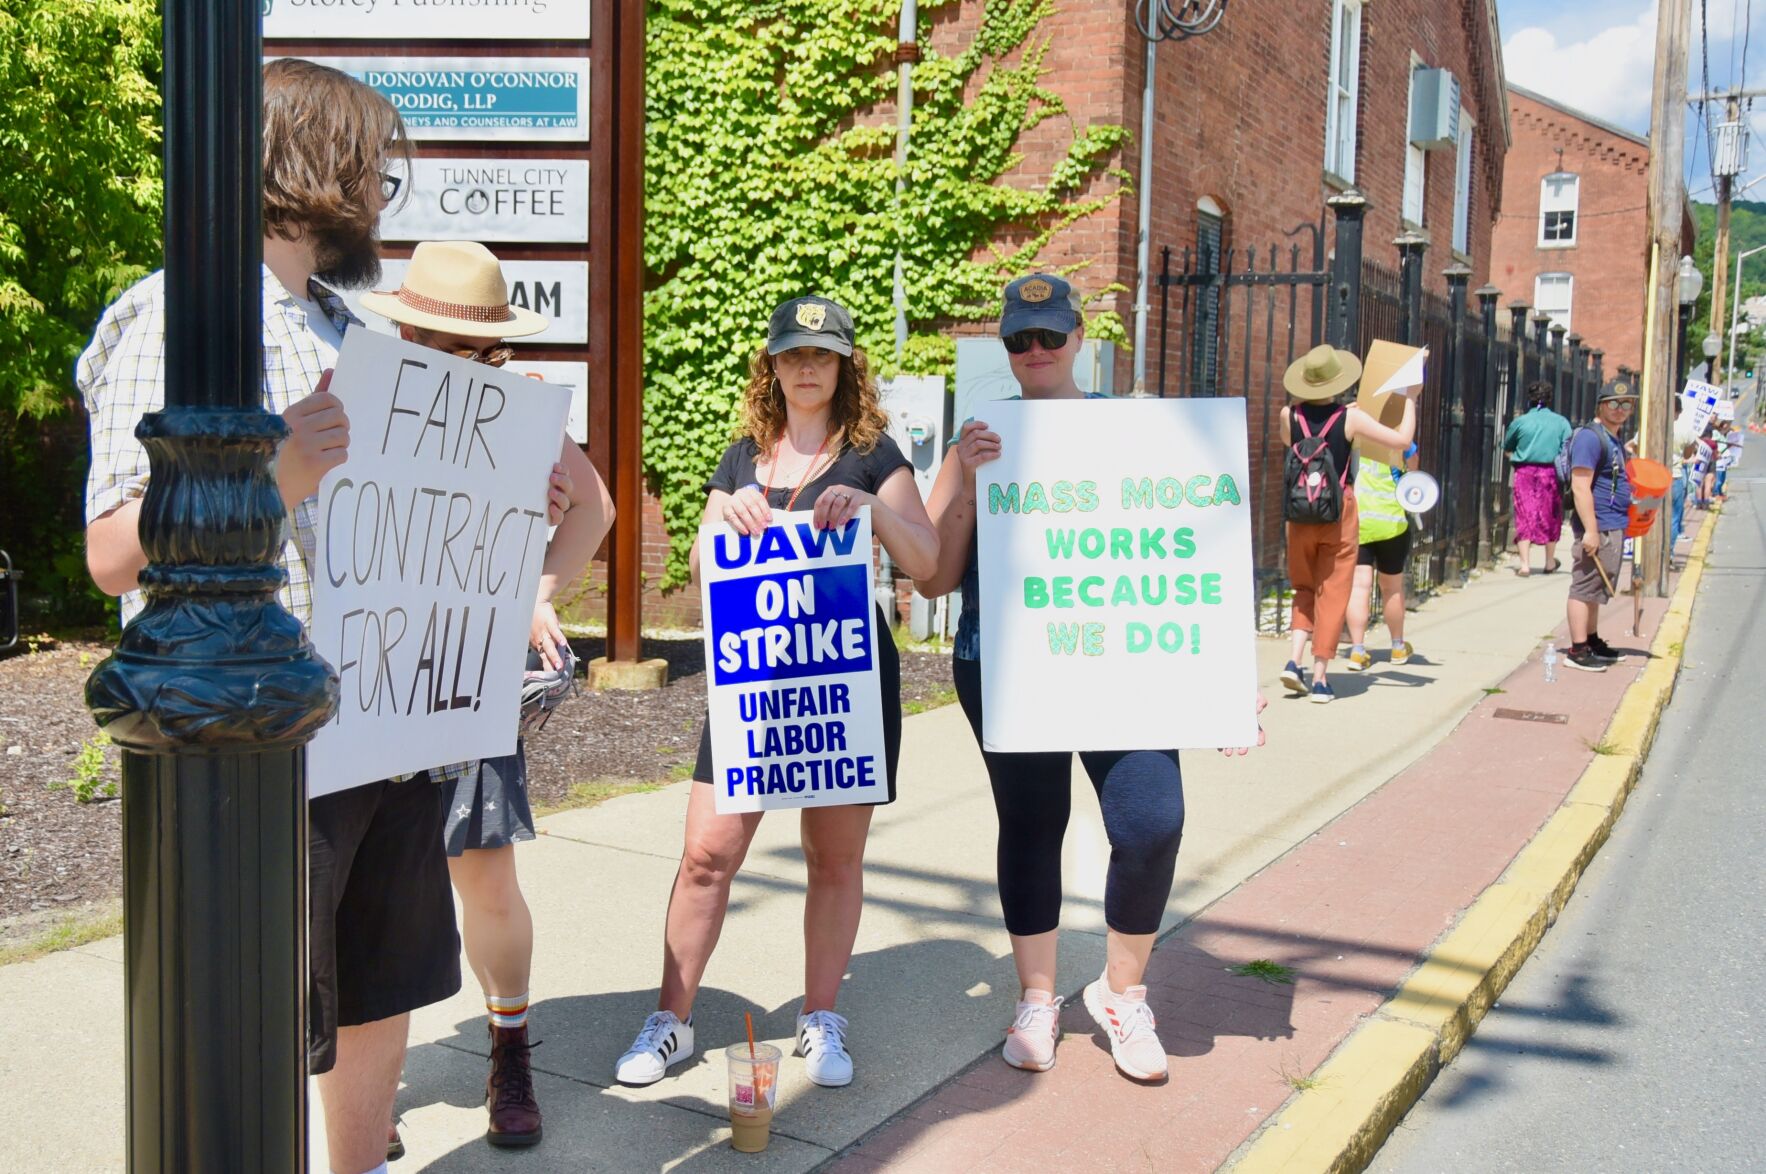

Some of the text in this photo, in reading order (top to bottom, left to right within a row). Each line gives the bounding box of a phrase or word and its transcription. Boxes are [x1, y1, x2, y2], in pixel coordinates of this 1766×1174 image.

[368, 72, 577, 88] DONOVAN O'CONNOR
[391, 93, 497, 111] DODIG, LLP
[433, 116, 458, 127] AND
[461, 116, 533, 127] COUNSELORS
[535, 117, 550, 127] AT
[552, 117, 577, 127] LAW
[439, 168, 568, 185] TUNNEL CITY
[440, 188, 565, 216] COFFEE
[380, 358, 506, 470] FAIR
[988, 473, 1242, 514] MASS MOCA
[325, 477, 544, 600] CONTRACT
[714, 518, 861, 570] UAW
[1045, 527, 1197, 560] WORKS
[755, 574, 815, 621] ON
[1023, 572, 1222, 609] BECAUSE
[718, 618, 866, 674] STRIKE
[1047, 621, 1201, 656] WE DO!
[336, 601, 497, 726] FOR ALL!
[738, 683, 851, 723] UNFAIR
[747, 720, 847, 759] LABOR
[726, 755, 876, 797] PRACTICE
